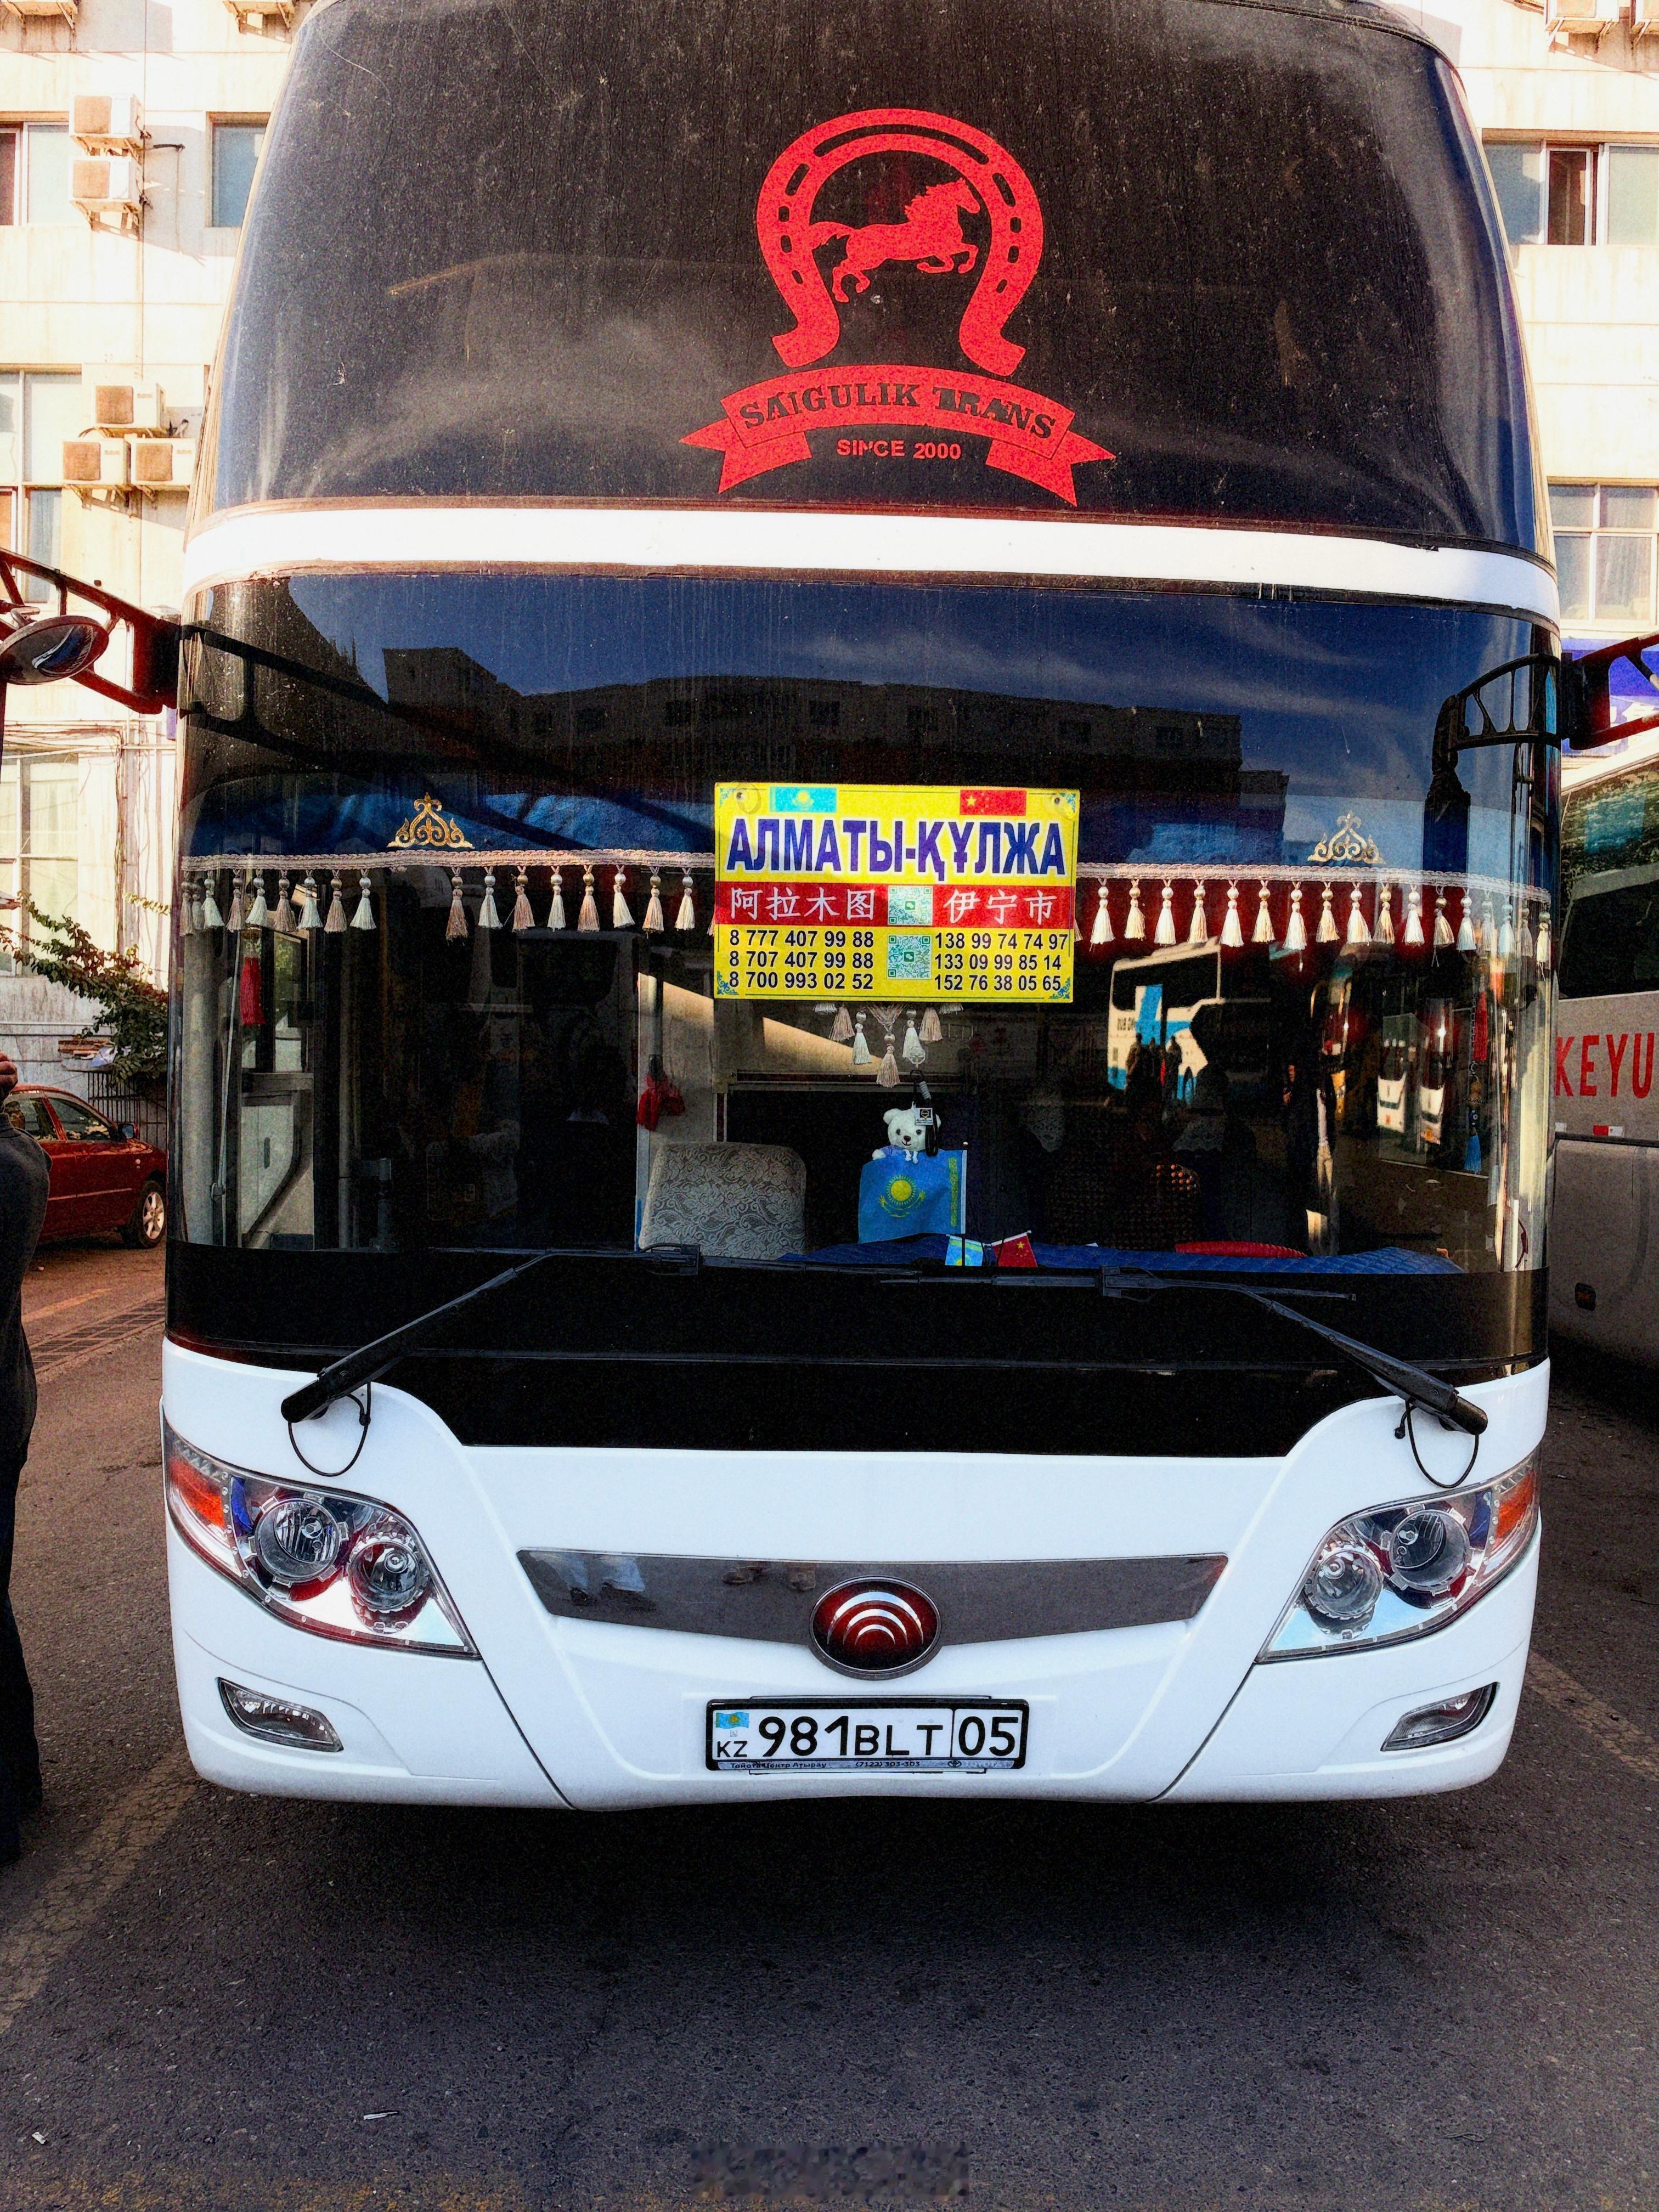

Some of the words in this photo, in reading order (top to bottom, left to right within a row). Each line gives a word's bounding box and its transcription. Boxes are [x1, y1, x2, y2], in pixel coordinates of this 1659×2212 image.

[740, 382, 922, 429] SAIGULIK
[933, 386, 1056, 439] TRANS
[837, 438, 905, 458] SINCE
[912, 441, 962, 460] 2000
[726, 818, 1065, 882] АЛМАТЫ-ҚҰЛЖА
[730, 886, 876, 921] 阿拉木图
[943, 889, 1057, 925] 伊宁市
[730, 930, 740, 946] 8
[746, 929, 779, 946] 777
[785, 930, 818, 947] 407
[824, 931, 846, 947] 99
[853, 931, 874, 948] 88
[935, 932, 965, 949] 138
[971, 933, 991, 949] 99
[998, 933, 1018, 950] 74
[1024, 934, 1043, 950] 74
[1048, 934, 1068, 950] 97
[729, 950, 740, 967] 8
[746, 951, 778, 967] 707
[785, 951, 817, 968] 407
[824, 952, 845, 968] 99
[852, 952, 873, 969] 88
[935, 954, 963, 970] 133
[969, 954, 988, 970] 09
[994, 954, 1013, 970] 99
[1019, 954, 1037, 970] 85
[1043, 955, 1062, 970] 14
[729, 971, 739, 988] 8
[746, 971, 778, 988] 700
[785, 972, 817, 989] 993
[824, 972, 845, 989] 02
[852, 973, 873, 990] 52
[934, 974, 963, 990] 152
[969, 974, 988, 991] 76
[994, 975, 1012, 991] 38
[1018, 975, 1037, 991] 05
[1042, 975, 1061, 991] 65
[1555, 1032, 1655, 1099] KEYU
[958, 1716, 1019, 1757] 05
[716, 1740, 748, 1758] KZ
